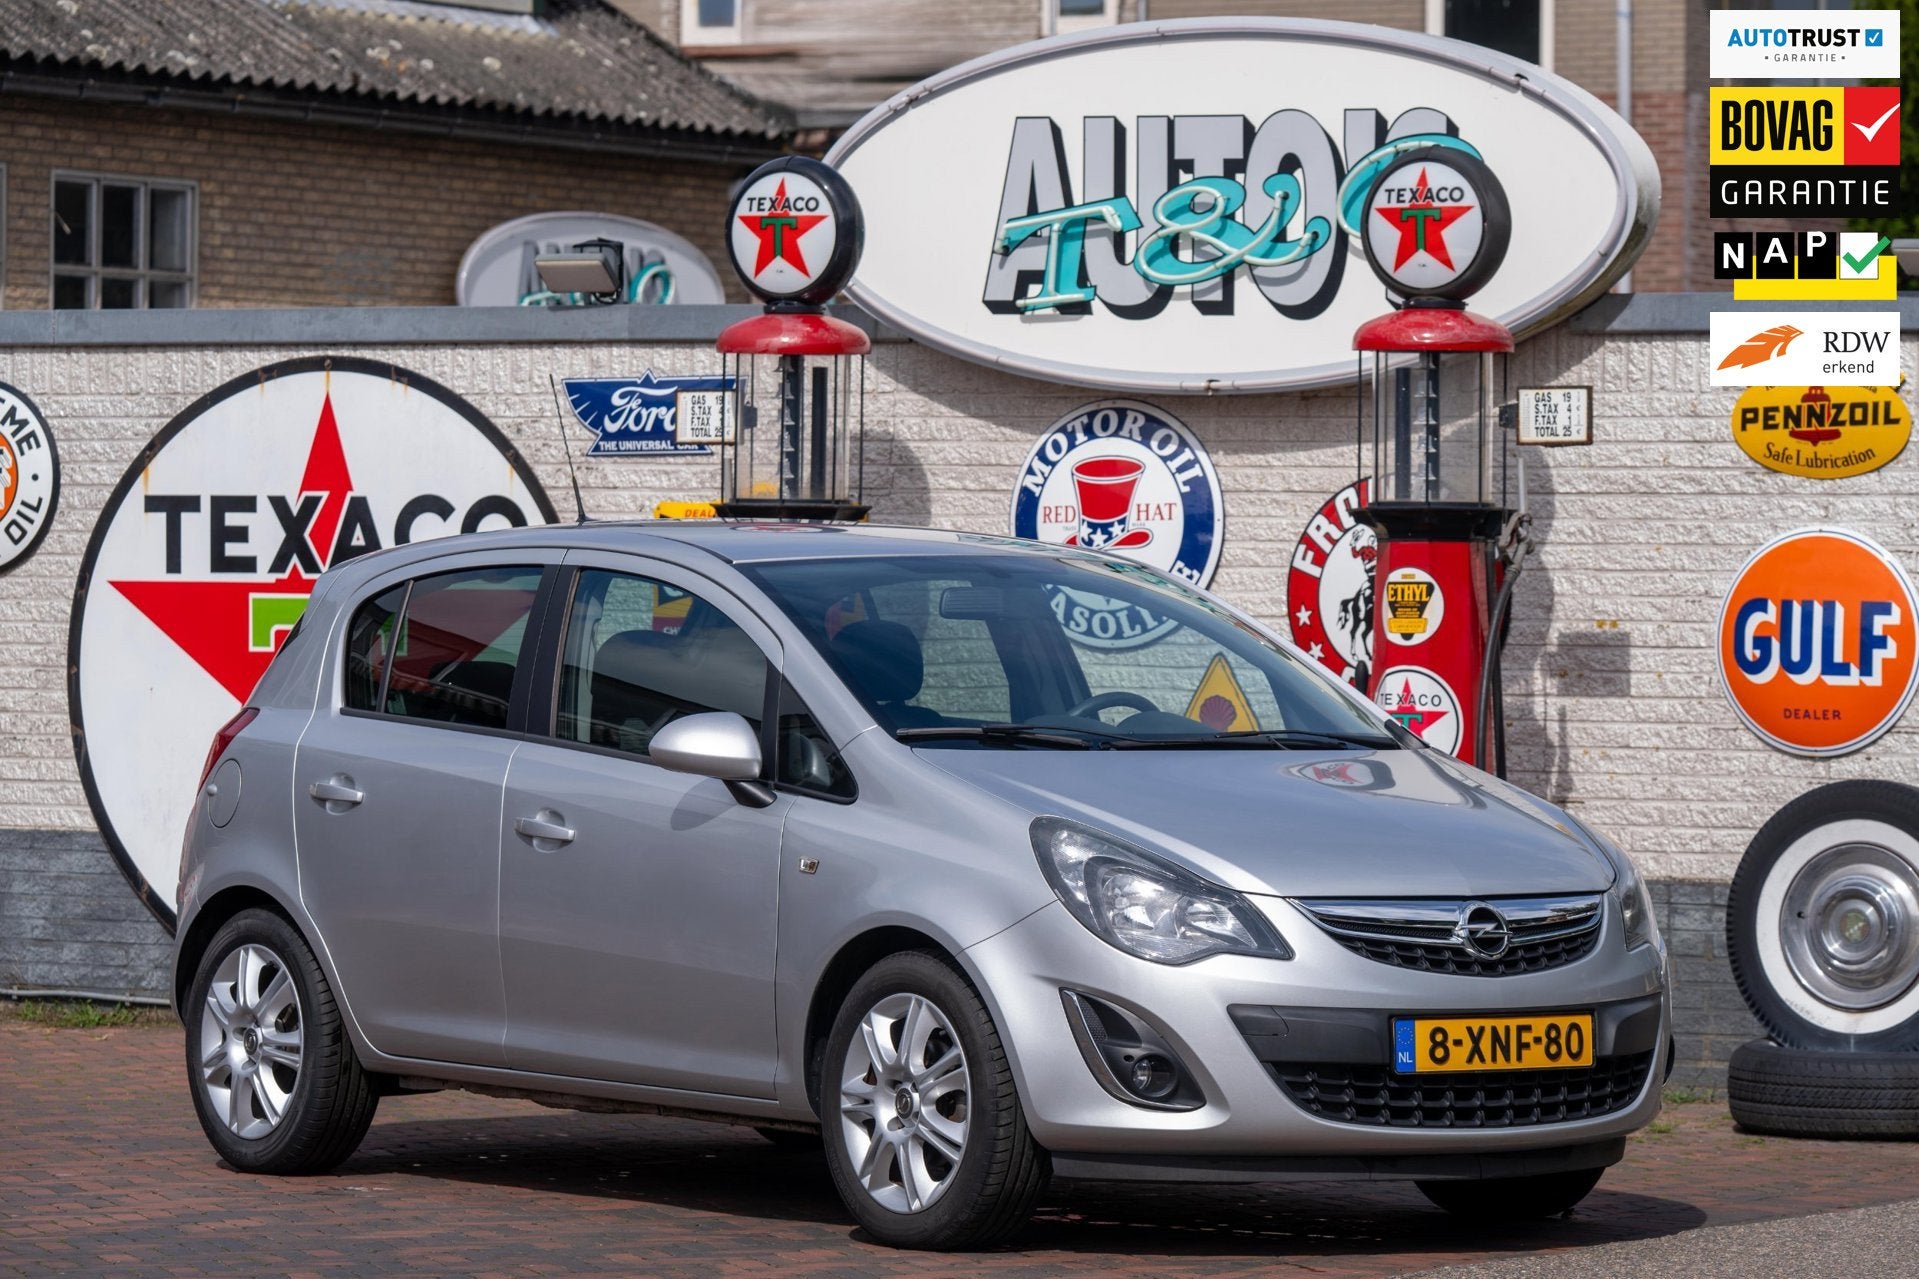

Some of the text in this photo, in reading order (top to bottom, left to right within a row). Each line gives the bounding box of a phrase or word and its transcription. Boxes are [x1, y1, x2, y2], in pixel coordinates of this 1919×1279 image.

[1385, 187, 1465, 204] TEXACO
[747, 197, 820, 212] TEXACO
[760, 217, 798, 257] T
[1401, 208, 1442, 251] T
[691, 395, 706, 405] GAS
[1534, 391, 1572, 403] GAS 19
[691, 406, 712, 416] S.TAX
[1535, 404, 1559, 414] S.TAX
[1567, 403, 1572, 413] 4
[1741, 401, 1901, 431] PENNZOIL
[691, 417, 710, 427] F.TAX
[1535, 415, 1557, 426] F.TAX
[691, 428, 712, 438] TOTAL
[1534, 427, 1559, 437] TOTAL
[1563, 425, 1572, 437] 25
[599, 440, 618, 451] THE
[618, 440, 674, 451] UNIVERSAL
[1023, 409, 1203, 498] MOTOR OIL
[1764, 442, 1876, 469] Safe Lubrication
[1043, 502, 1177, 524] RED HAT
[4, 496, 43, 546] OIL
[1388, 584, 1430, 601] ETHYL
[1734, 597, 1901, 687] GULF
[1783, 708, 1842, 720] DEALER
[1428, 1022, 1585, 1065] 8-XNF-80
[1398, 1052, 1413, 1063] NL
